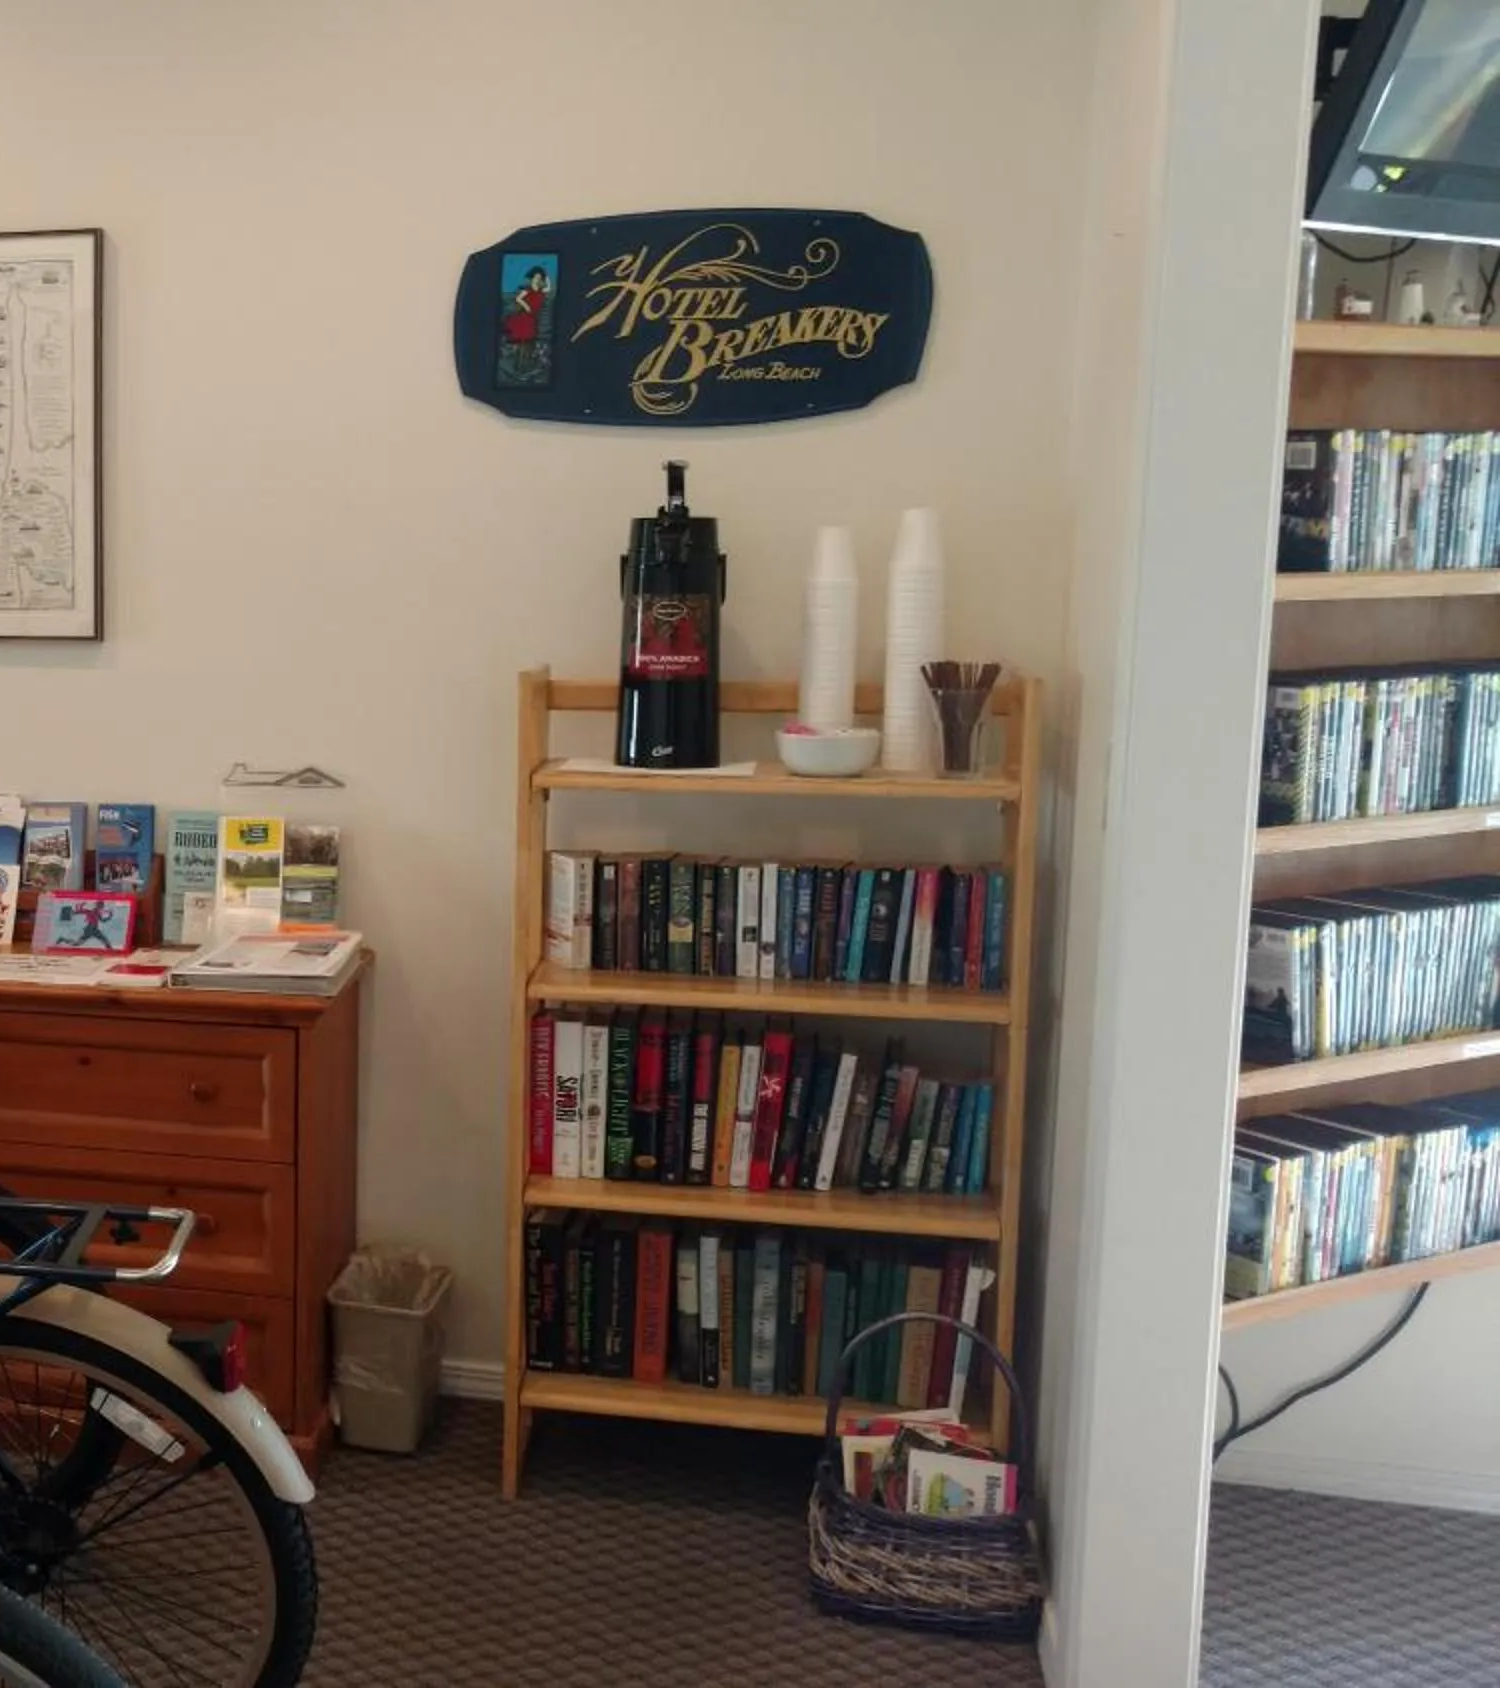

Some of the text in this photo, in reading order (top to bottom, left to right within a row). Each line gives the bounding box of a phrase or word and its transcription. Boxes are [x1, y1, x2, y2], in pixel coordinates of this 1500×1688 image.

[571, 240, 748, 341] HOTEL
[630, 305, 890, 404] BREAKERS
[717, 361, 822, 381] LONG BEACH
[555, 1075, 579, 1123] SATORI
